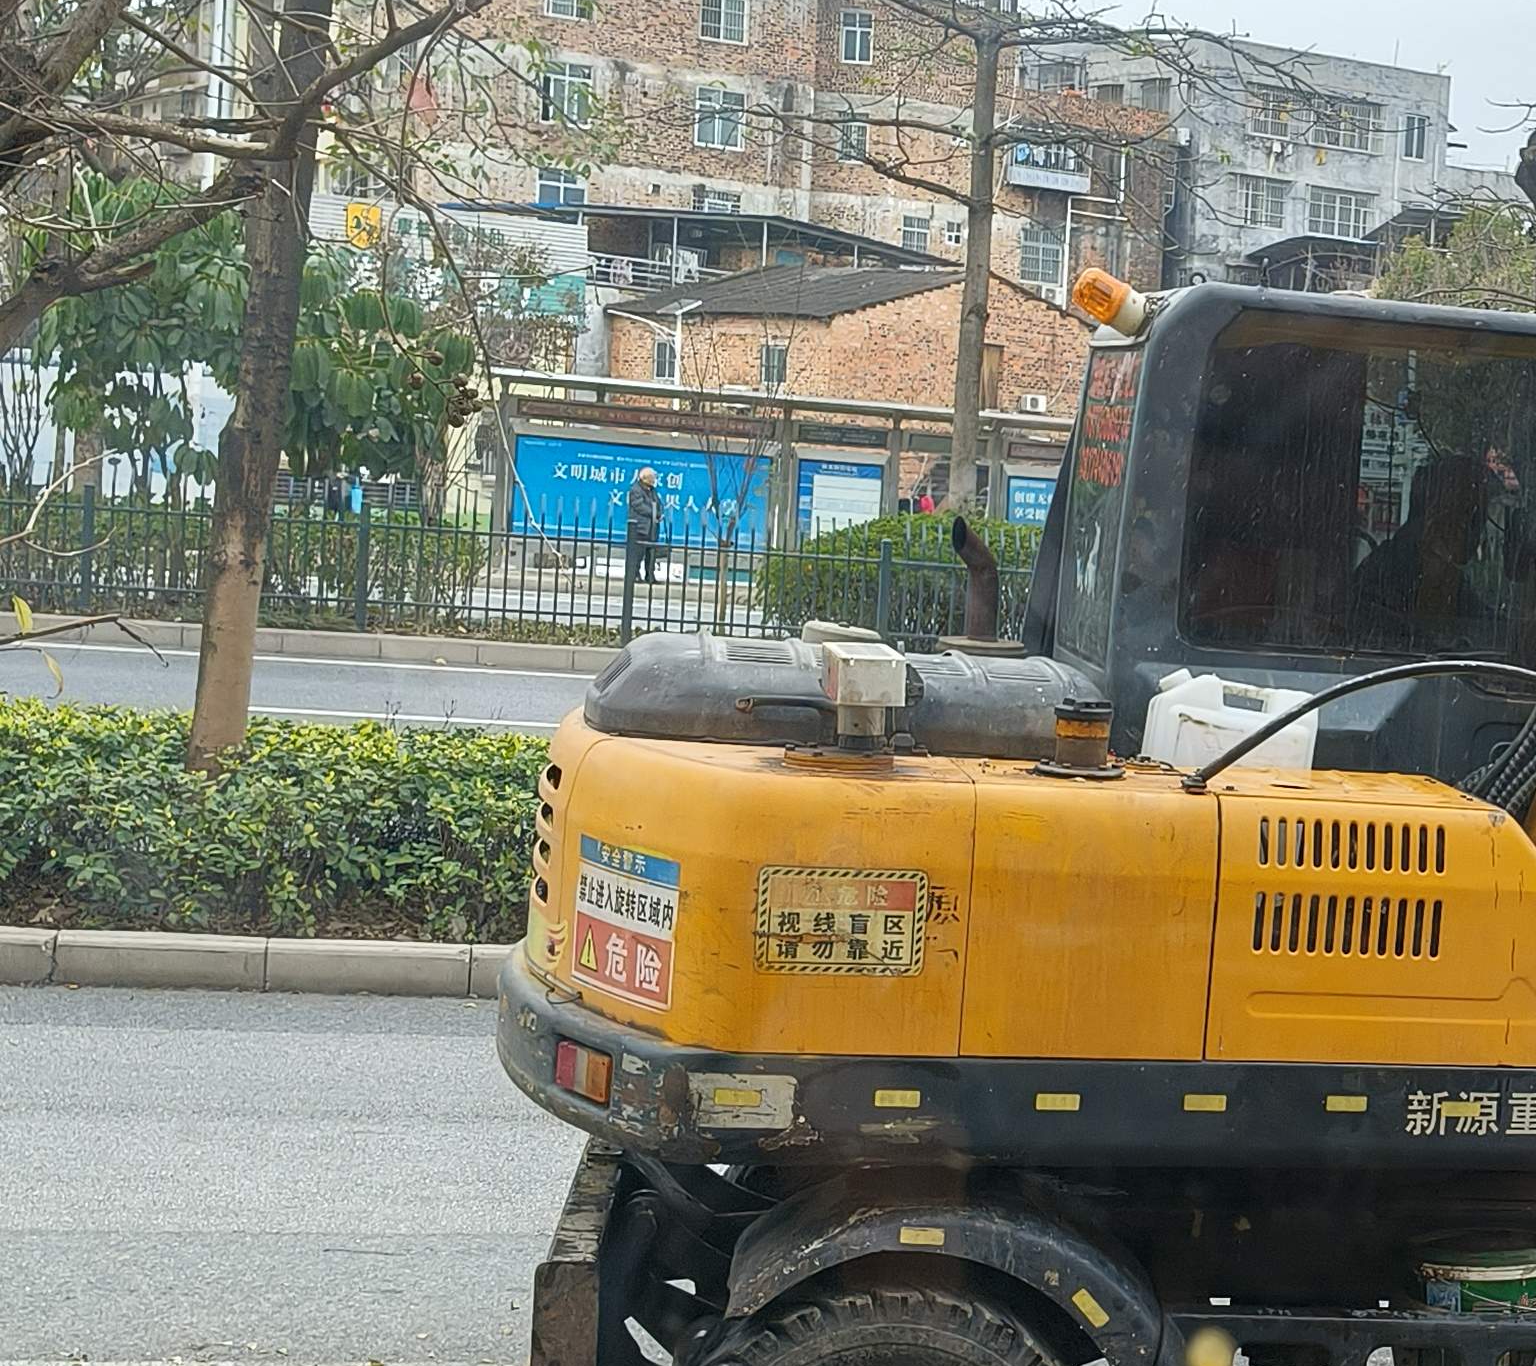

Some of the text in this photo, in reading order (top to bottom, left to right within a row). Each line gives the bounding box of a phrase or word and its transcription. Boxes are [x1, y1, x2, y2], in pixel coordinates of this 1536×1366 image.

[553, 462, 684, 491] 文明城市家创
[600, 844, 646, 874] 安全警示
[579, 875, 674, 931] 禁止进入旋转区域内
[836, 885, 889, 907] 危险
[777, 911, 906, 935] 视线盲区
[605, 933, 662, 993] 危险
[776, 939, 904, 961] 请勿靠近
